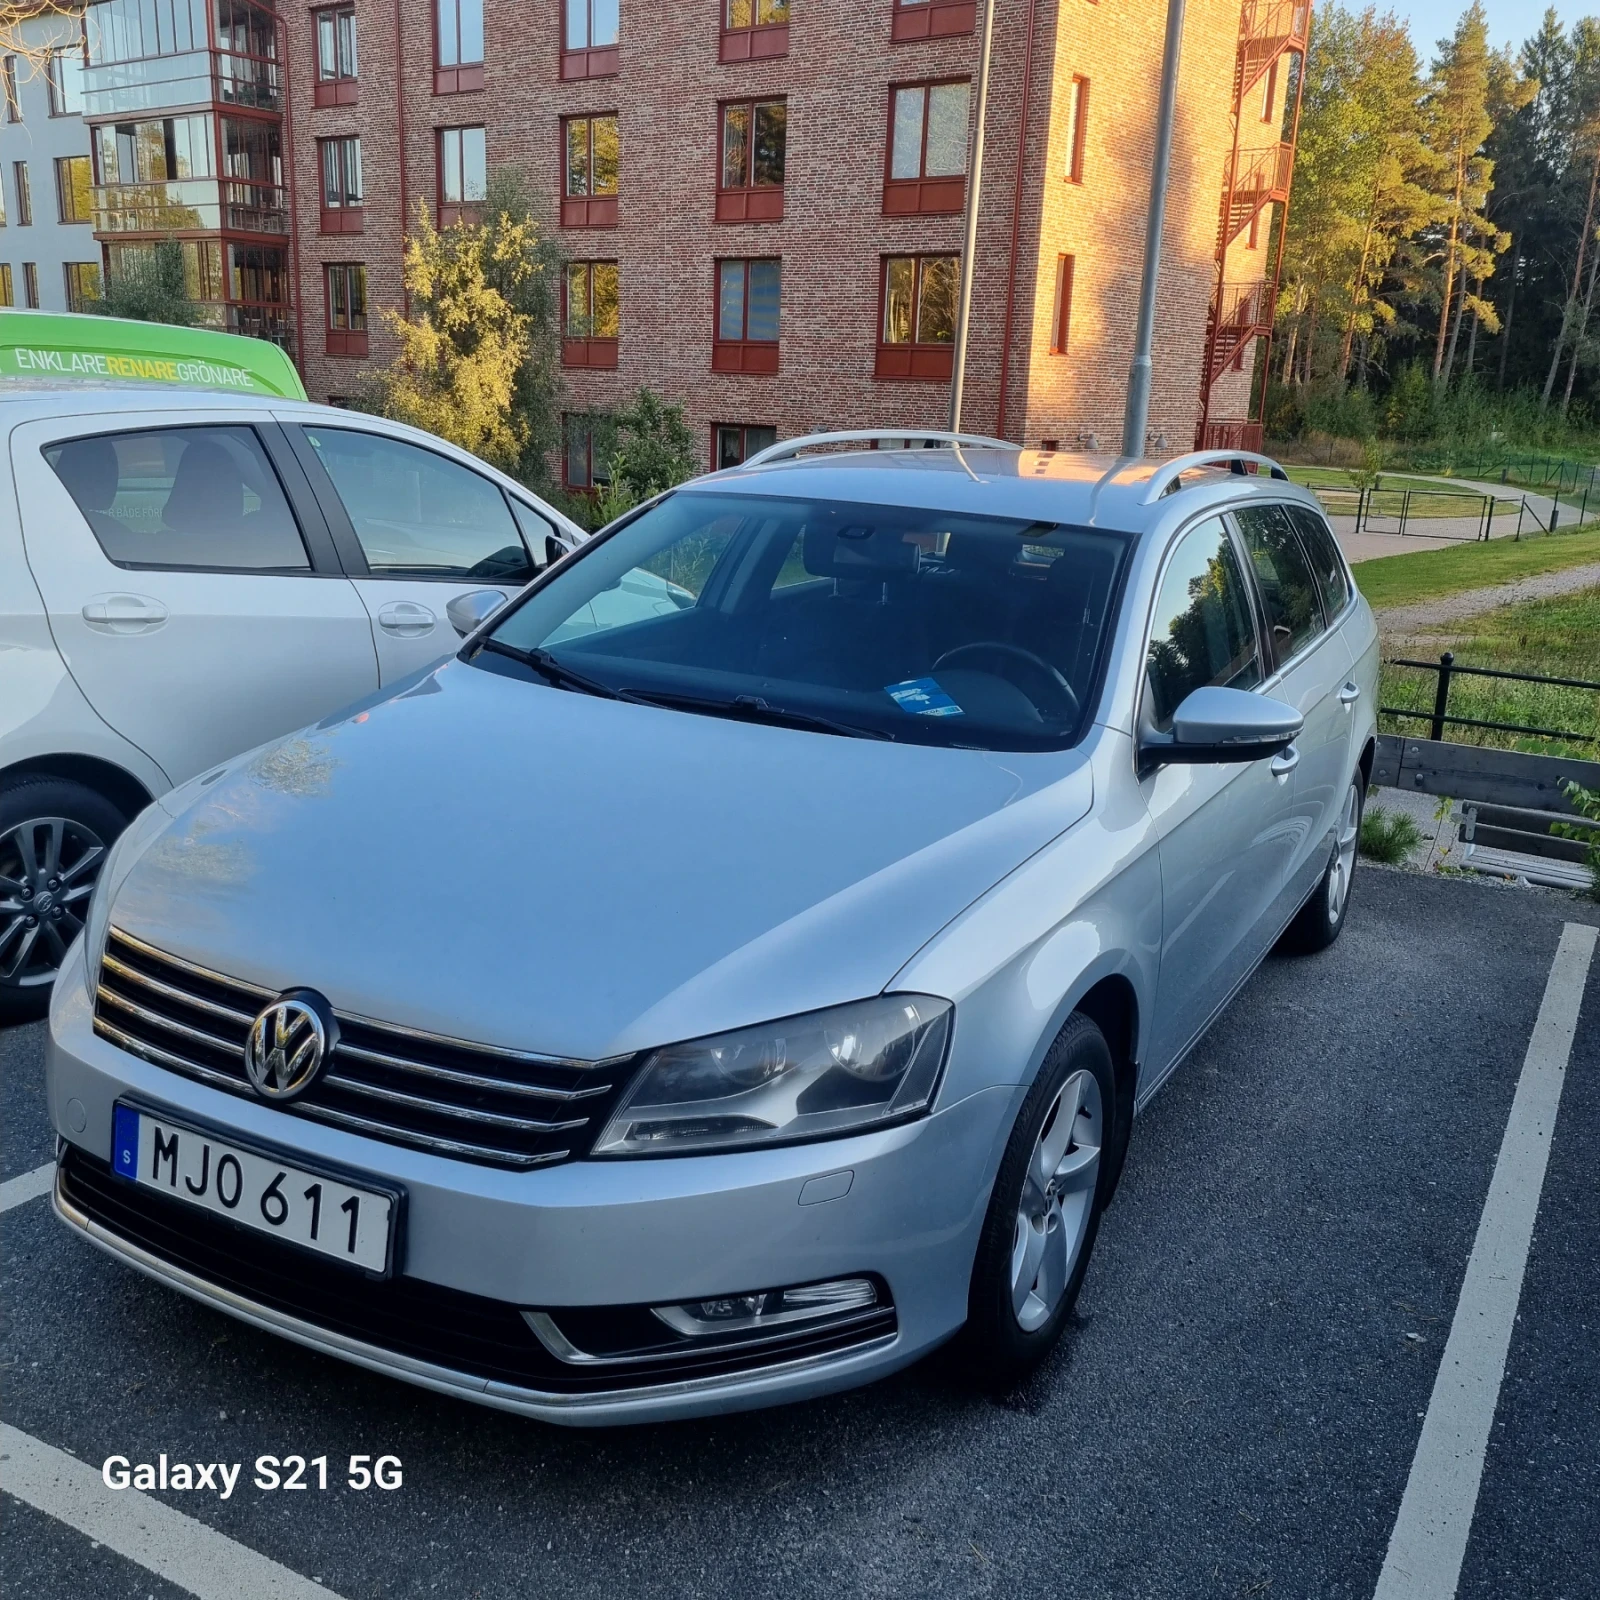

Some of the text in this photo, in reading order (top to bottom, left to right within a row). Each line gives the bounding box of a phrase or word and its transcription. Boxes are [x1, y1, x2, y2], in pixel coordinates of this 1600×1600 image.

[122, 1149, 131, 1165] S
[153, 1125, 361, 1254] MJO 611
